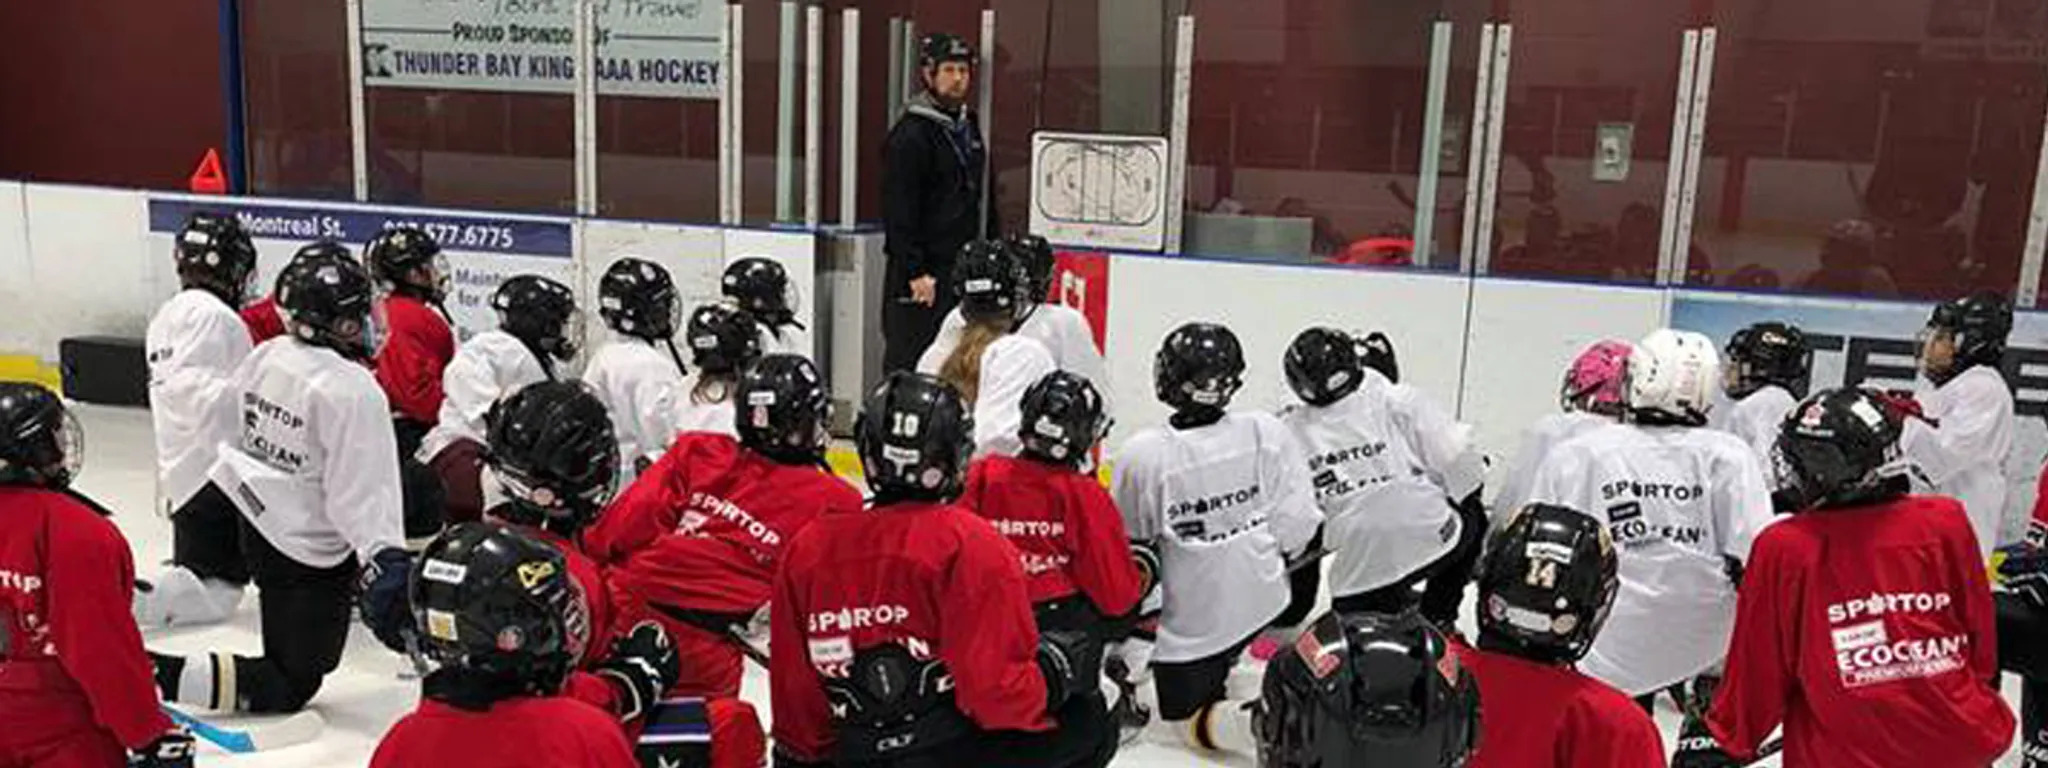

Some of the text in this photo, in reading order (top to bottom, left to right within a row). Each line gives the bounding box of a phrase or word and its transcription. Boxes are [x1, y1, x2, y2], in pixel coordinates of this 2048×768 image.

[453, 22, 504, 41] PROUD
[509, 24, 574, 44] SPONSO
[394, 51, 720, 84] THUNDER BAY KING AAA HOCKEY
[237, 211, 319, 236] Montreal
[322, 217, 346, 238] St.
[455, 268, 500, 287] Maint
[893, 412, 920, 437] 10
[1525, 558, 1557, 589] 14
[808, 604, 909, 633] SPOROP
